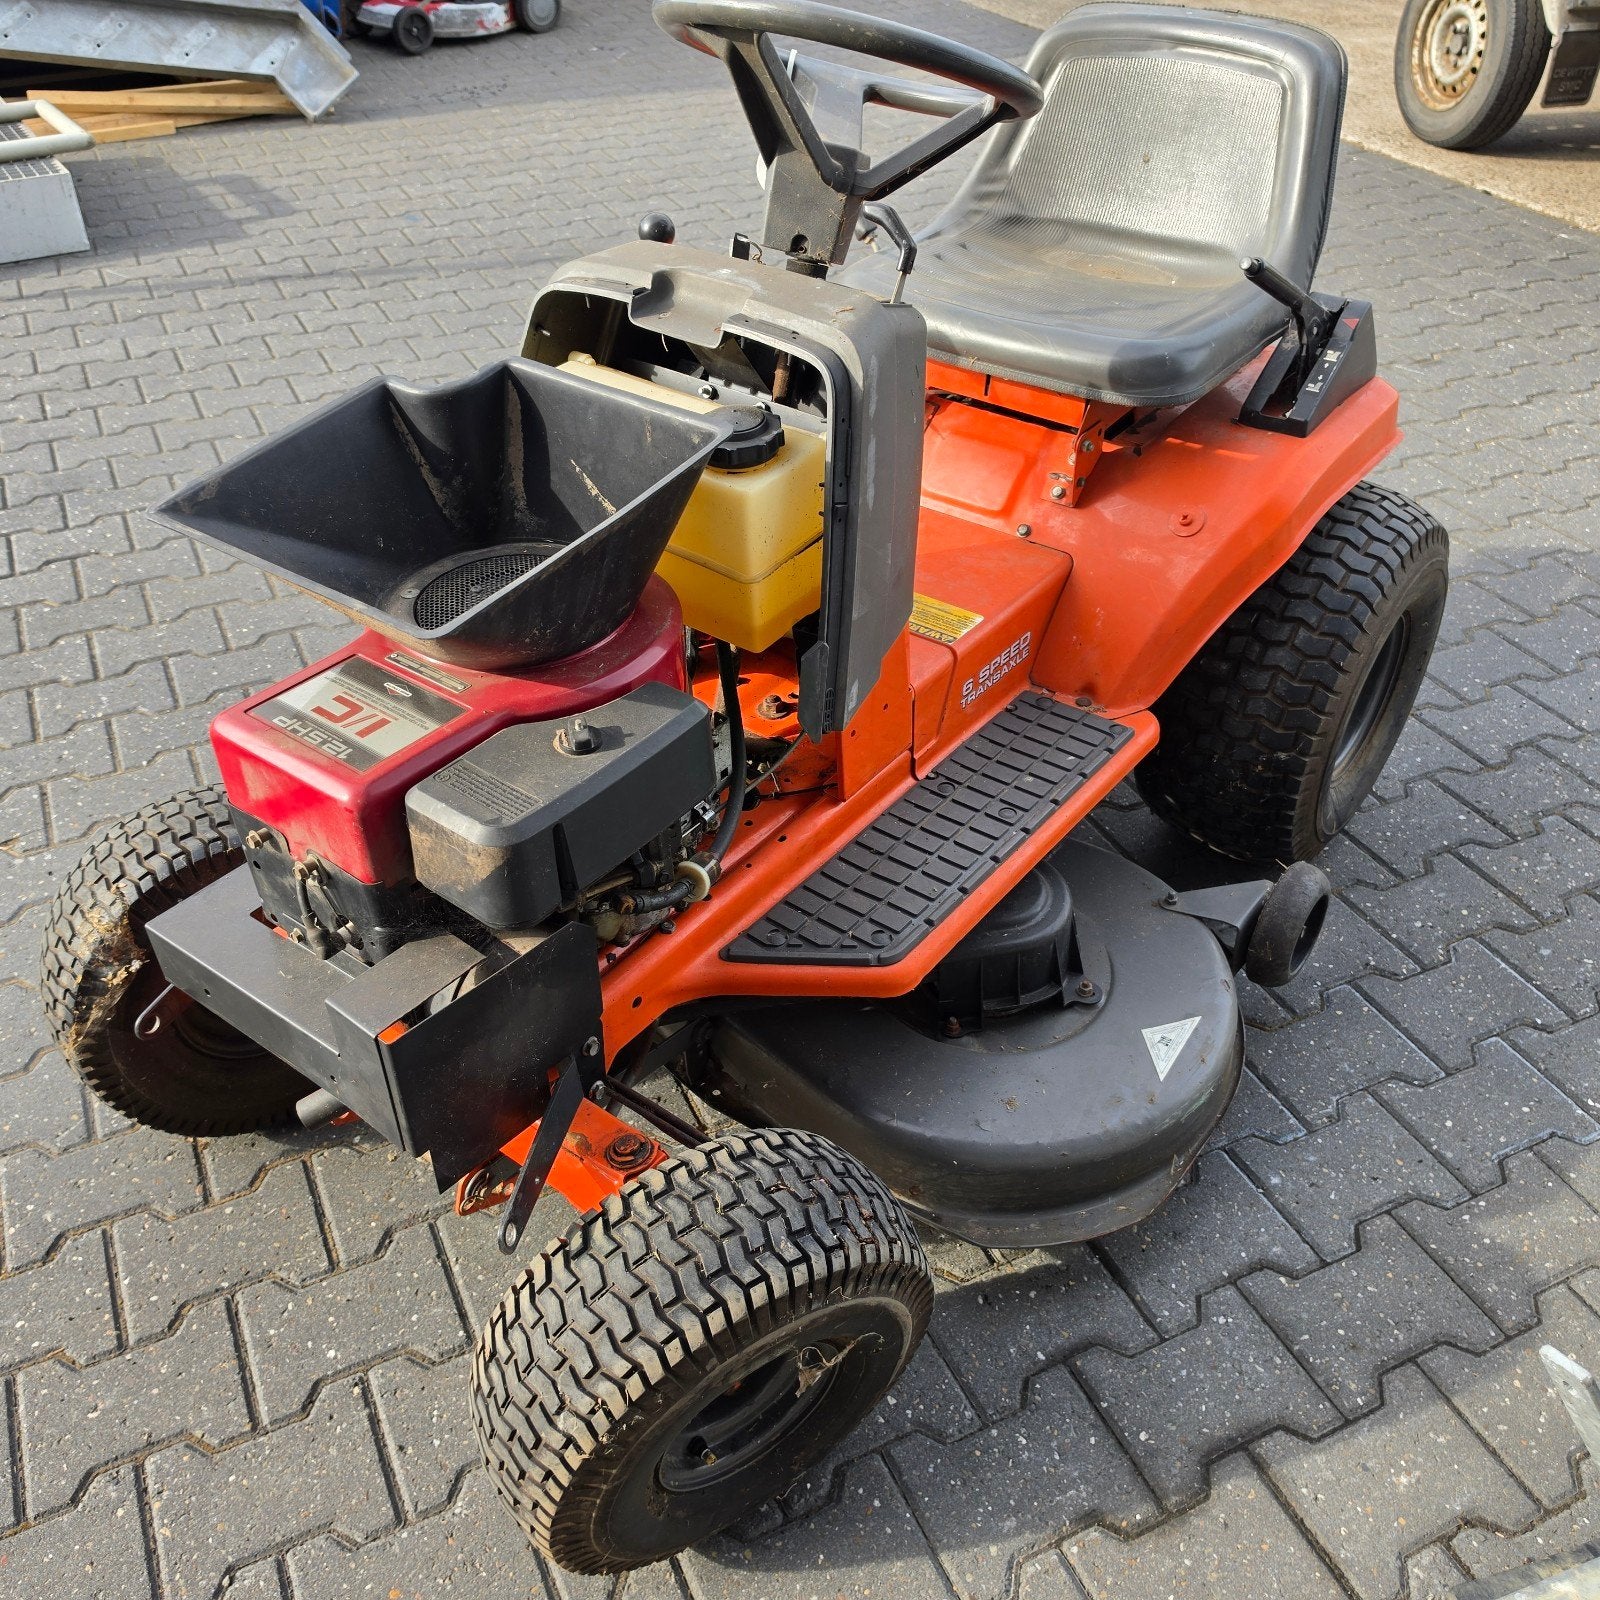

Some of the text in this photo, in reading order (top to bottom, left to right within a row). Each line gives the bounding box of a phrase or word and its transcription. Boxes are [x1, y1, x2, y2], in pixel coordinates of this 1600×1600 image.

[960, 645, 1030, 709] TRANSAXLE
[962, 631, 1032, 696] 6 SPEED
[310, 693, 393, 739] I/C
